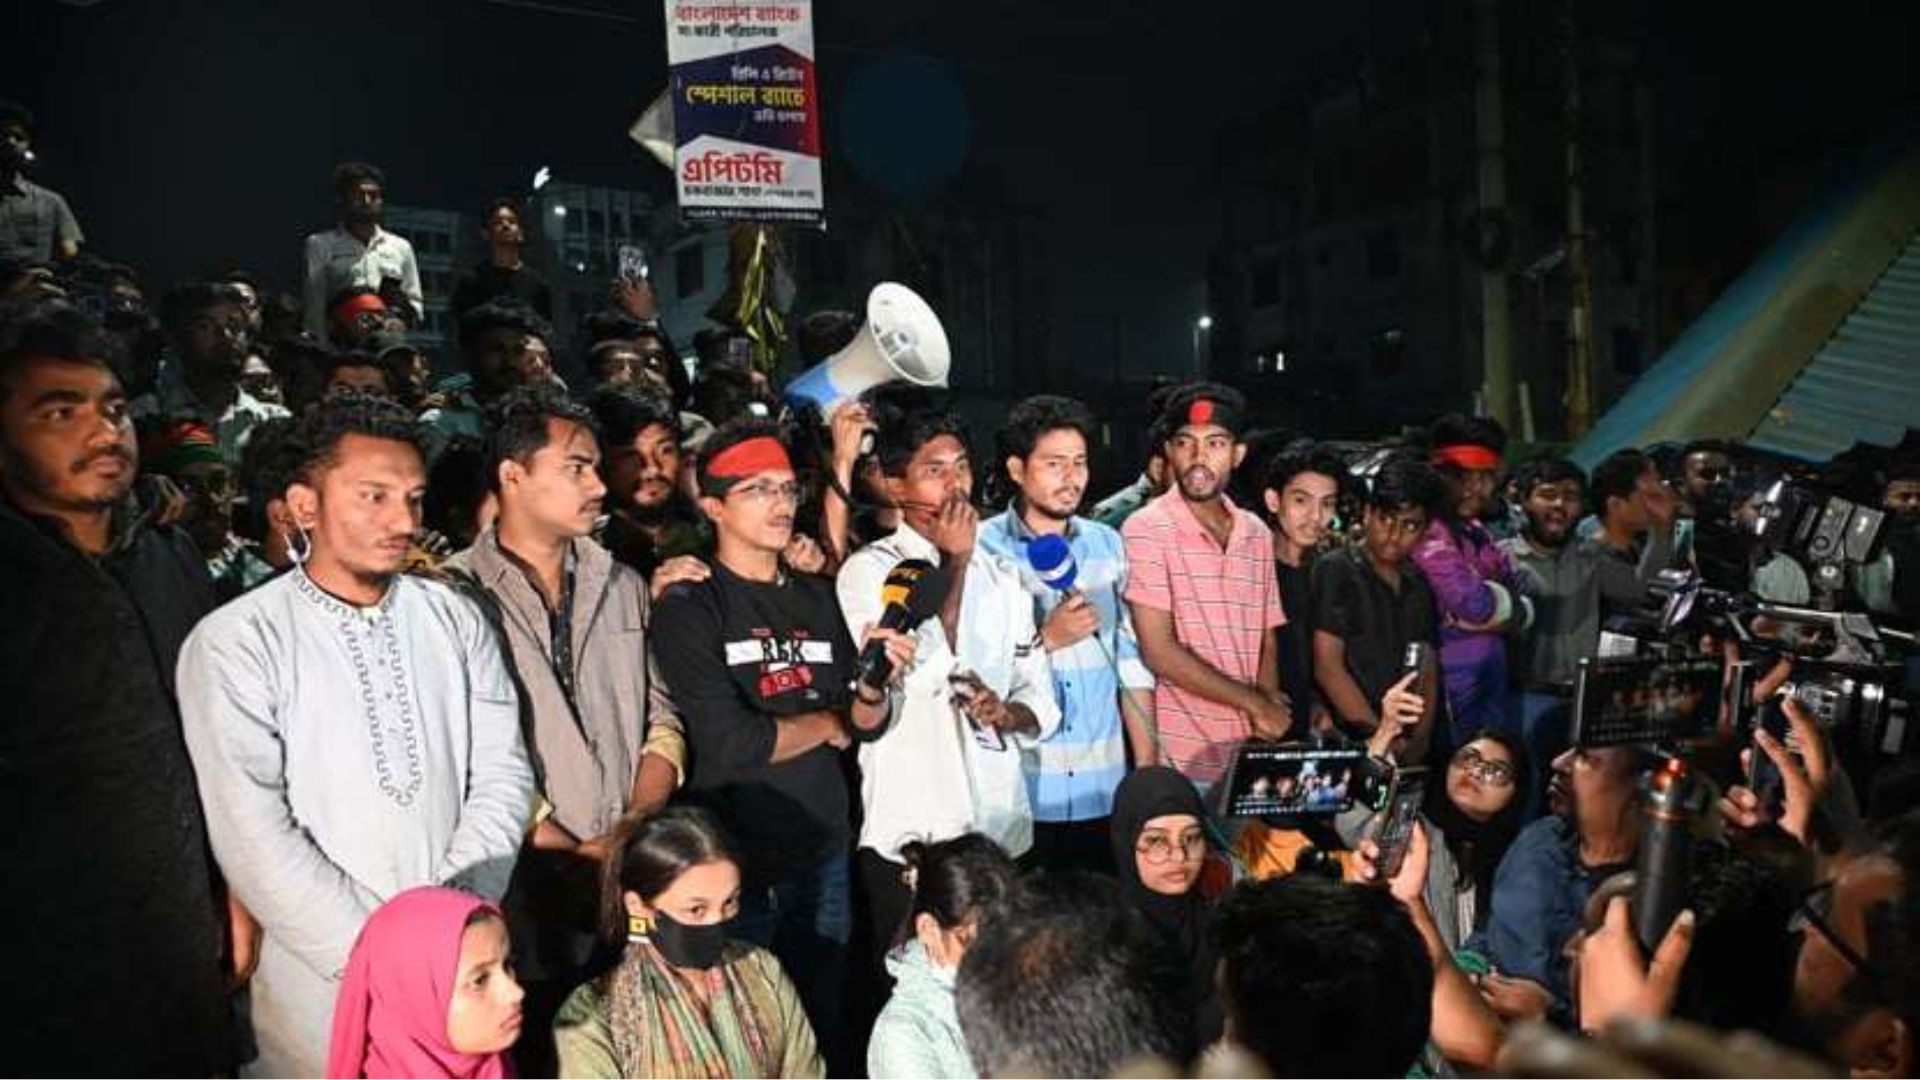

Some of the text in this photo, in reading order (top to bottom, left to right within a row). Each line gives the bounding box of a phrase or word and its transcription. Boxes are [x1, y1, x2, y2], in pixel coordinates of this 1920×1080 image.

[675, 5, 750, 22] বাংলাদেশ
[686, 85, 756, 105] স্পেশাল
[683, 150, 783, 185] এপিটমি
